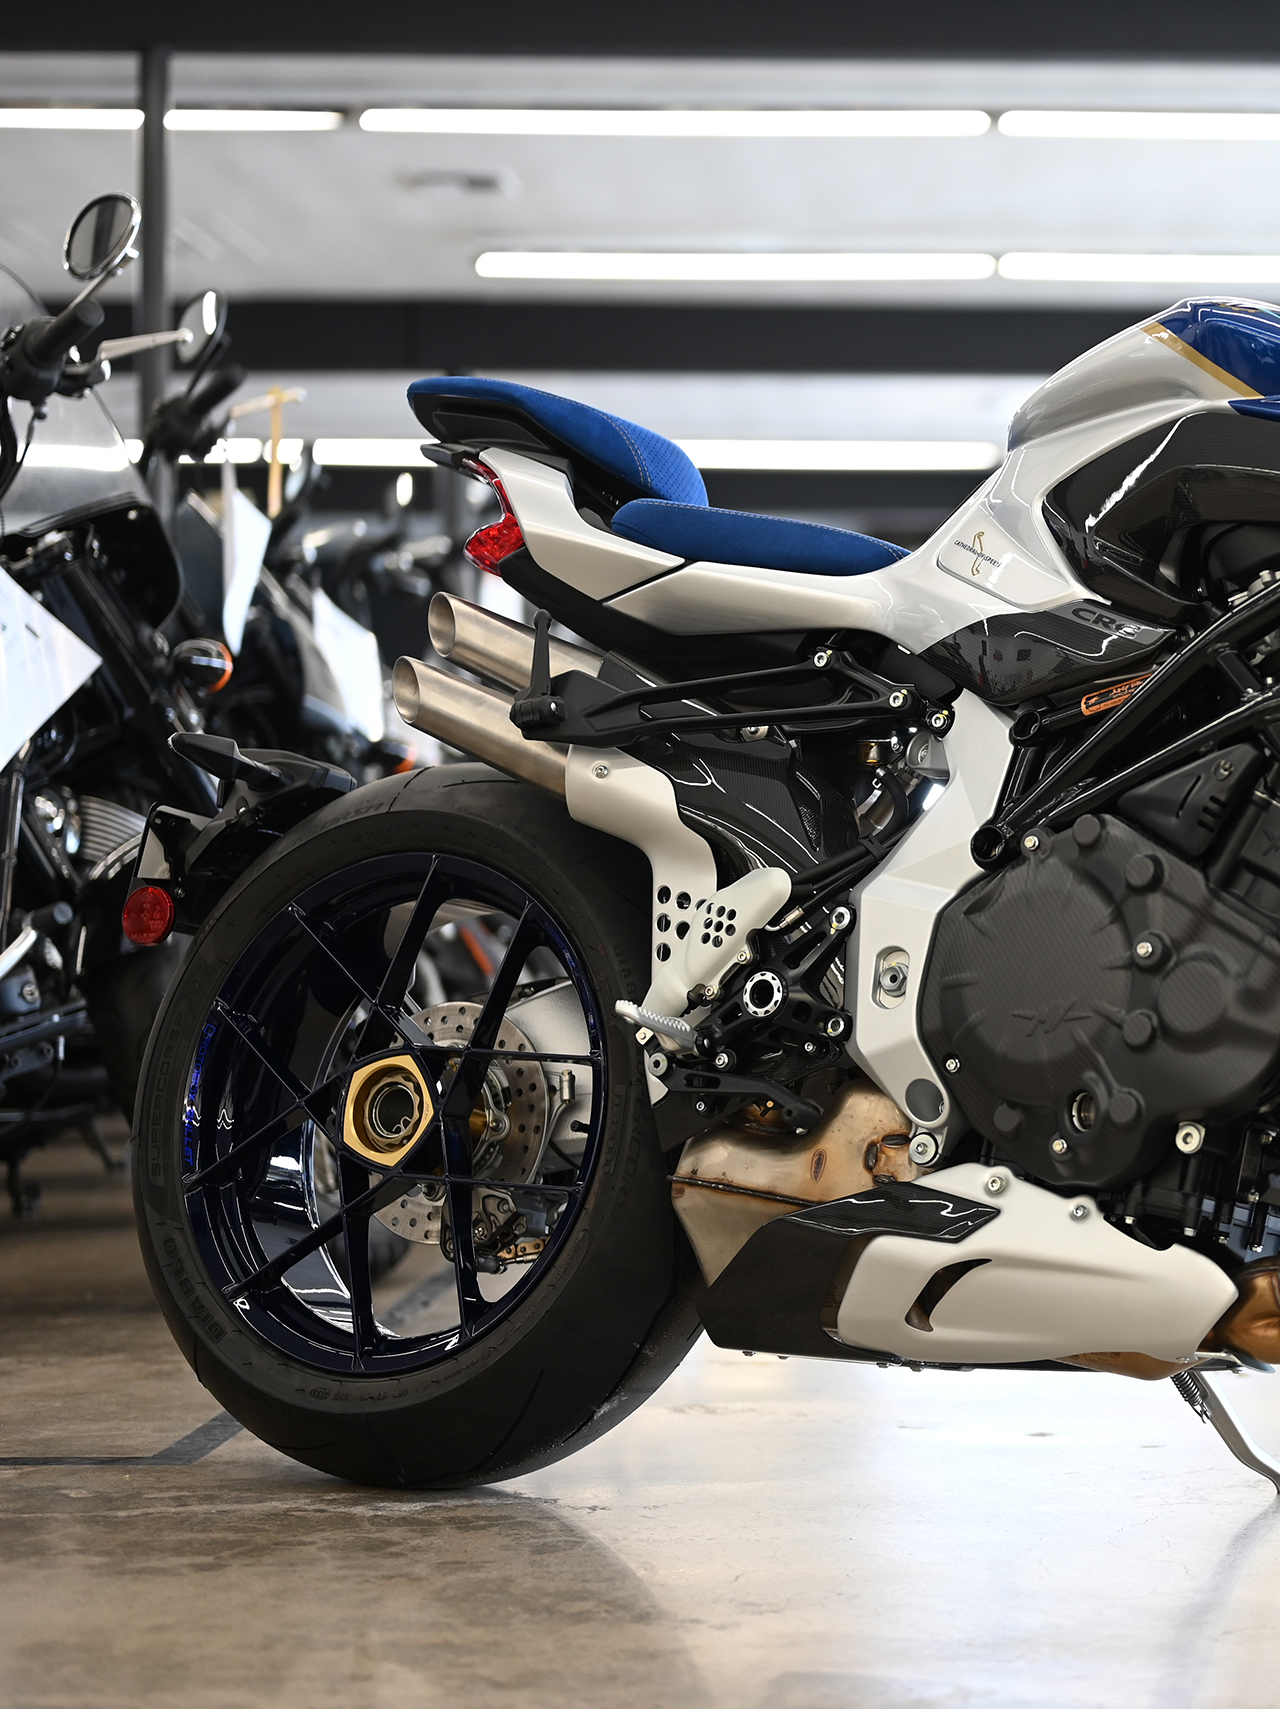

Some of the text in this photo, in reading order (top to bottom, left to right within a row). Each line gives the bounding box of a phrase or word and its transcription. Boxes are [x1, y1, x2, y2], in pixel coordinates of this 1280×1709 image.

[953, 539, 977, 556] CATHEDRAL
[150, 1011, 186, 1180] SUPERCORSA
[189, 1034, 212, 1101] ROTOBOX
[163, 1236, 227, 1344] DIABLO
